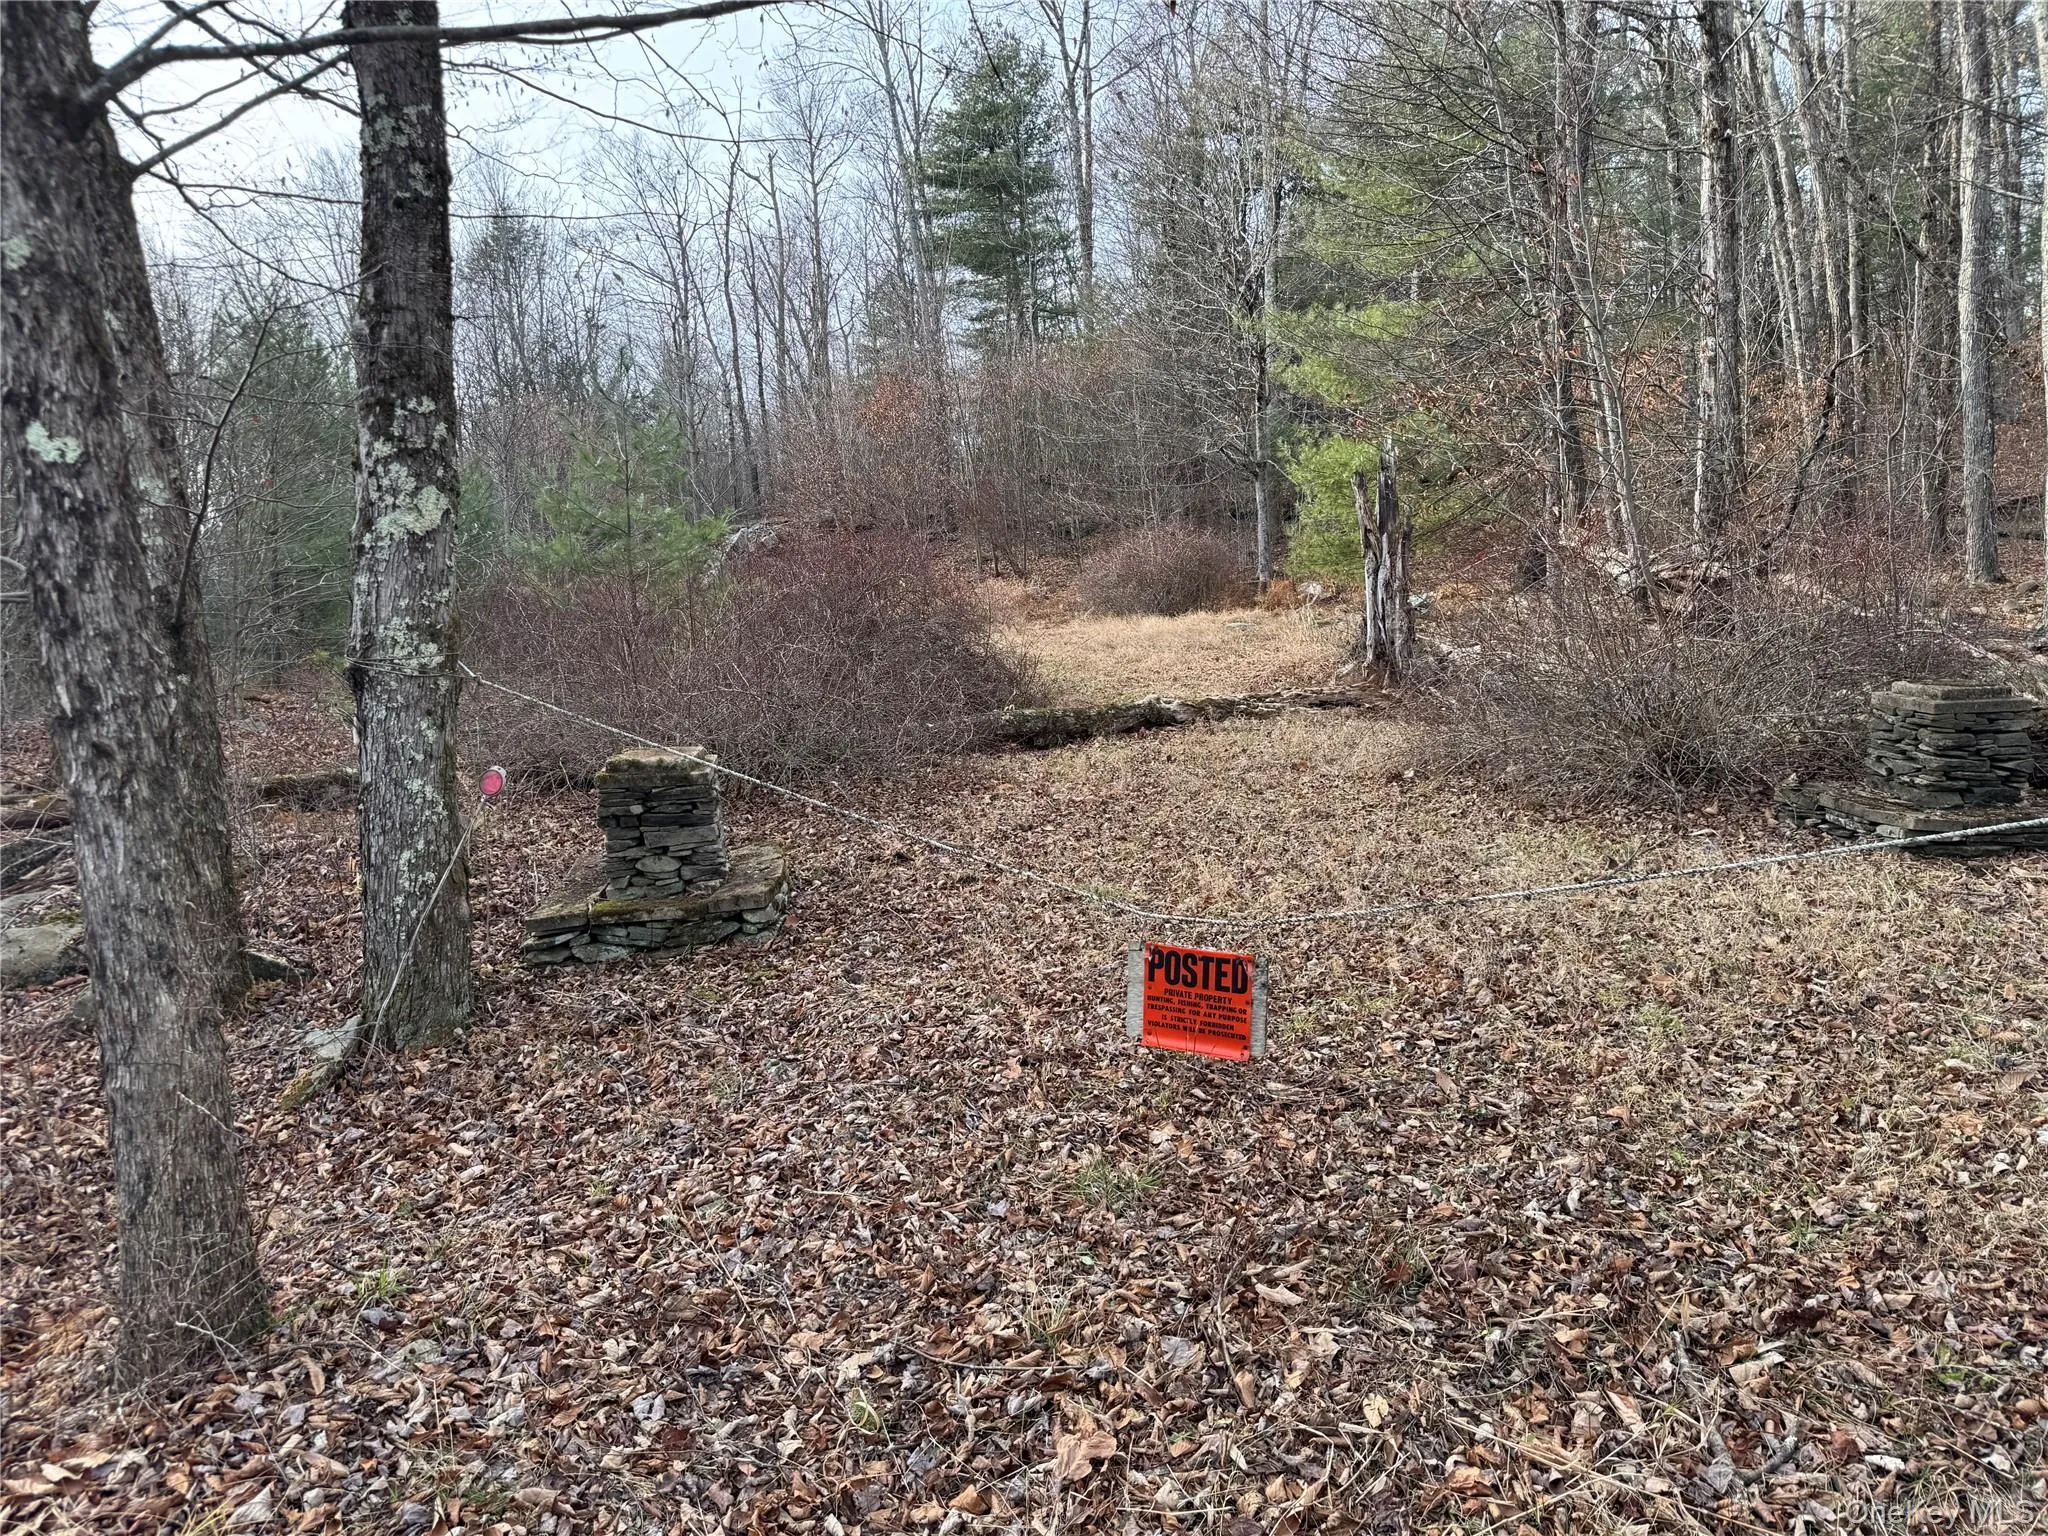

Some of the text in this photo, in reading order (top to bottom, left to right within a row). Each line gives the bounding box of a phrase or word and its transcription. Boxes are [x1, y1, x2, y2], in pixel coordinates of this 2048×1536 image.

[1148, 948, 1248, 994] POSTED
[1164, 988, 1232, 1005] PRIVATE PROPERTY
[1148, 1003, 1186, 1015] TRESPASSING
[1203, 1011, 1217, 1019] ANY
[1219, 1014, 1247, 1024] PURPOSE
[1206, 1003, 1237, 1014] TRAPPING
[1148, 1020, 1180, 1030] VIOLATORS
[1170, 1016, 1197, 1025] STRICTLY
[1200, 1020, 1234, 1031] FORBIDDEN
